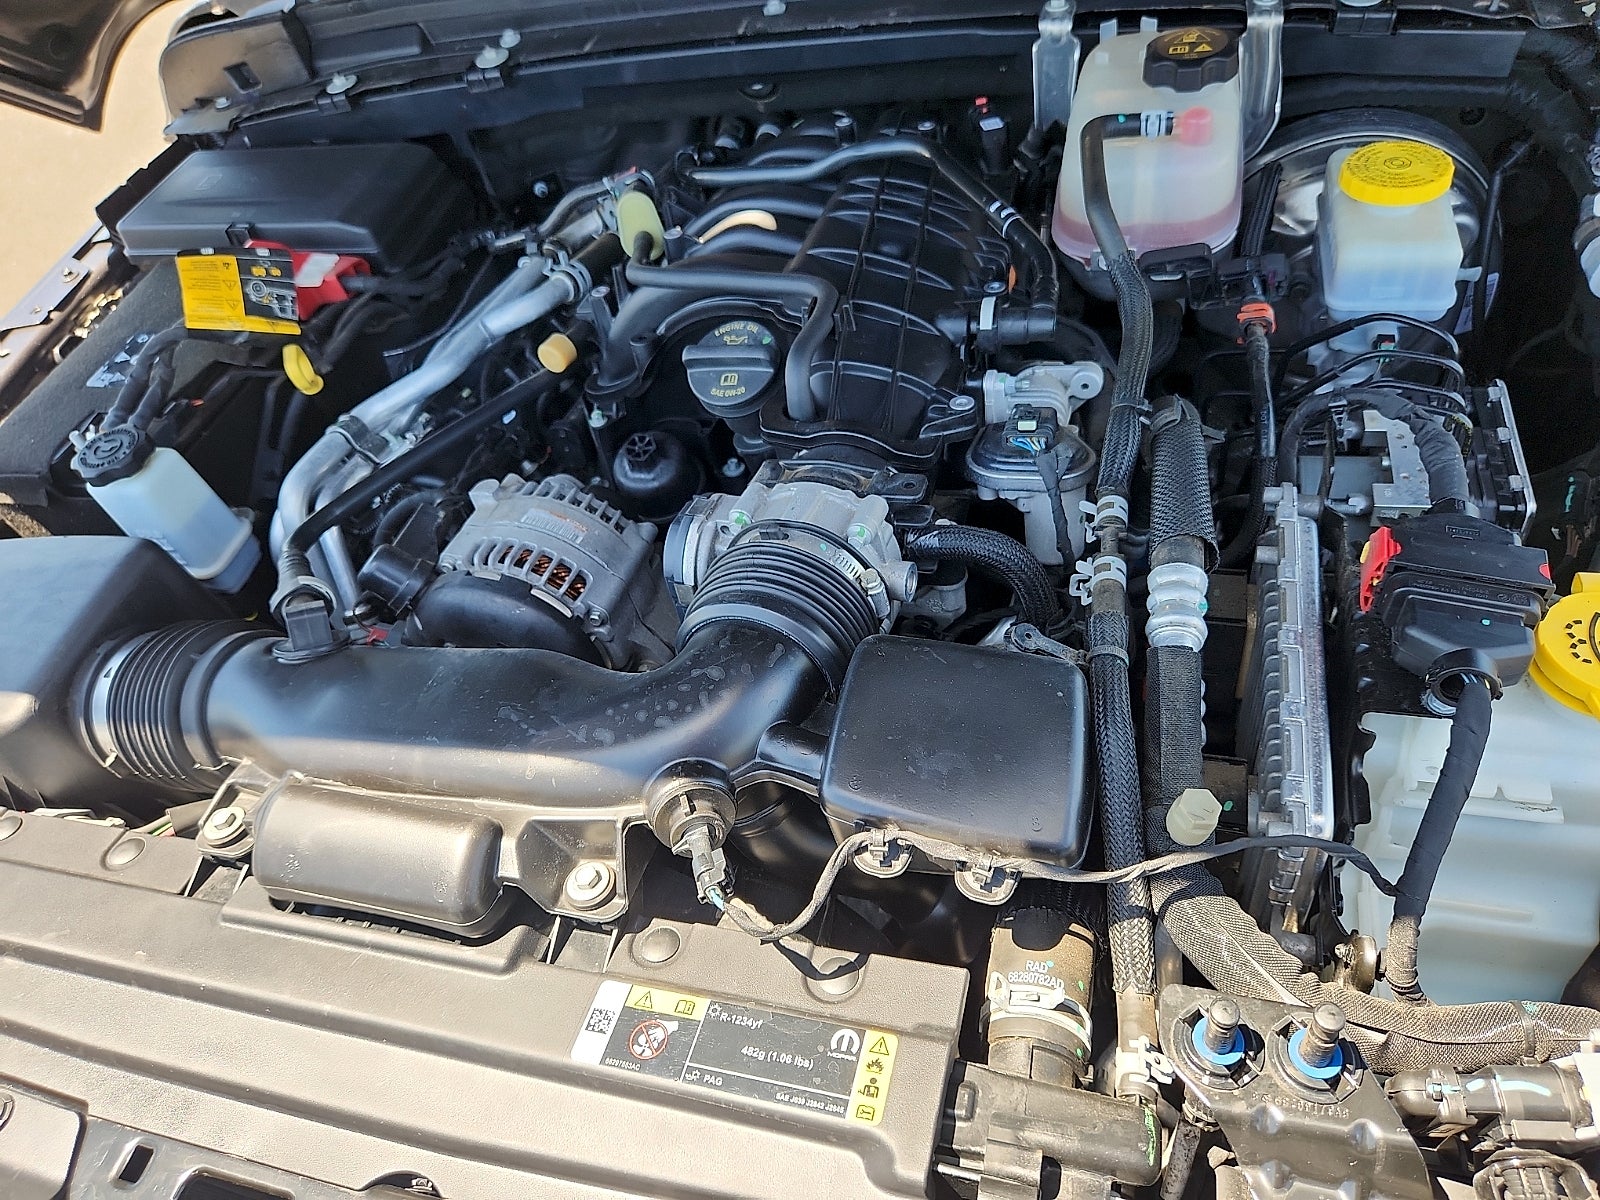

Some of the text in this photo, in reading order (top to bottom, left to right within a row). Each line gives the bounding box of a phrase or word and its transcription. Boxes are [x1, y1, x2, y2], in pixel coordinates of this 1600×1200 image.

[714, 322, 759, 337] ENGINE OIL
[710, 387, 724, 397] SAE
[1025, 960, 1048, 974] RAD
[1008, 971, 1064, 989] 68280782AD
[719, 1012, 763, 1030] R-1234yf
[740, 1045, 766, 1061] 482g
[794, 1055, 814, 1071] lbs)
[703, 1073, 723, 1086] PAG
